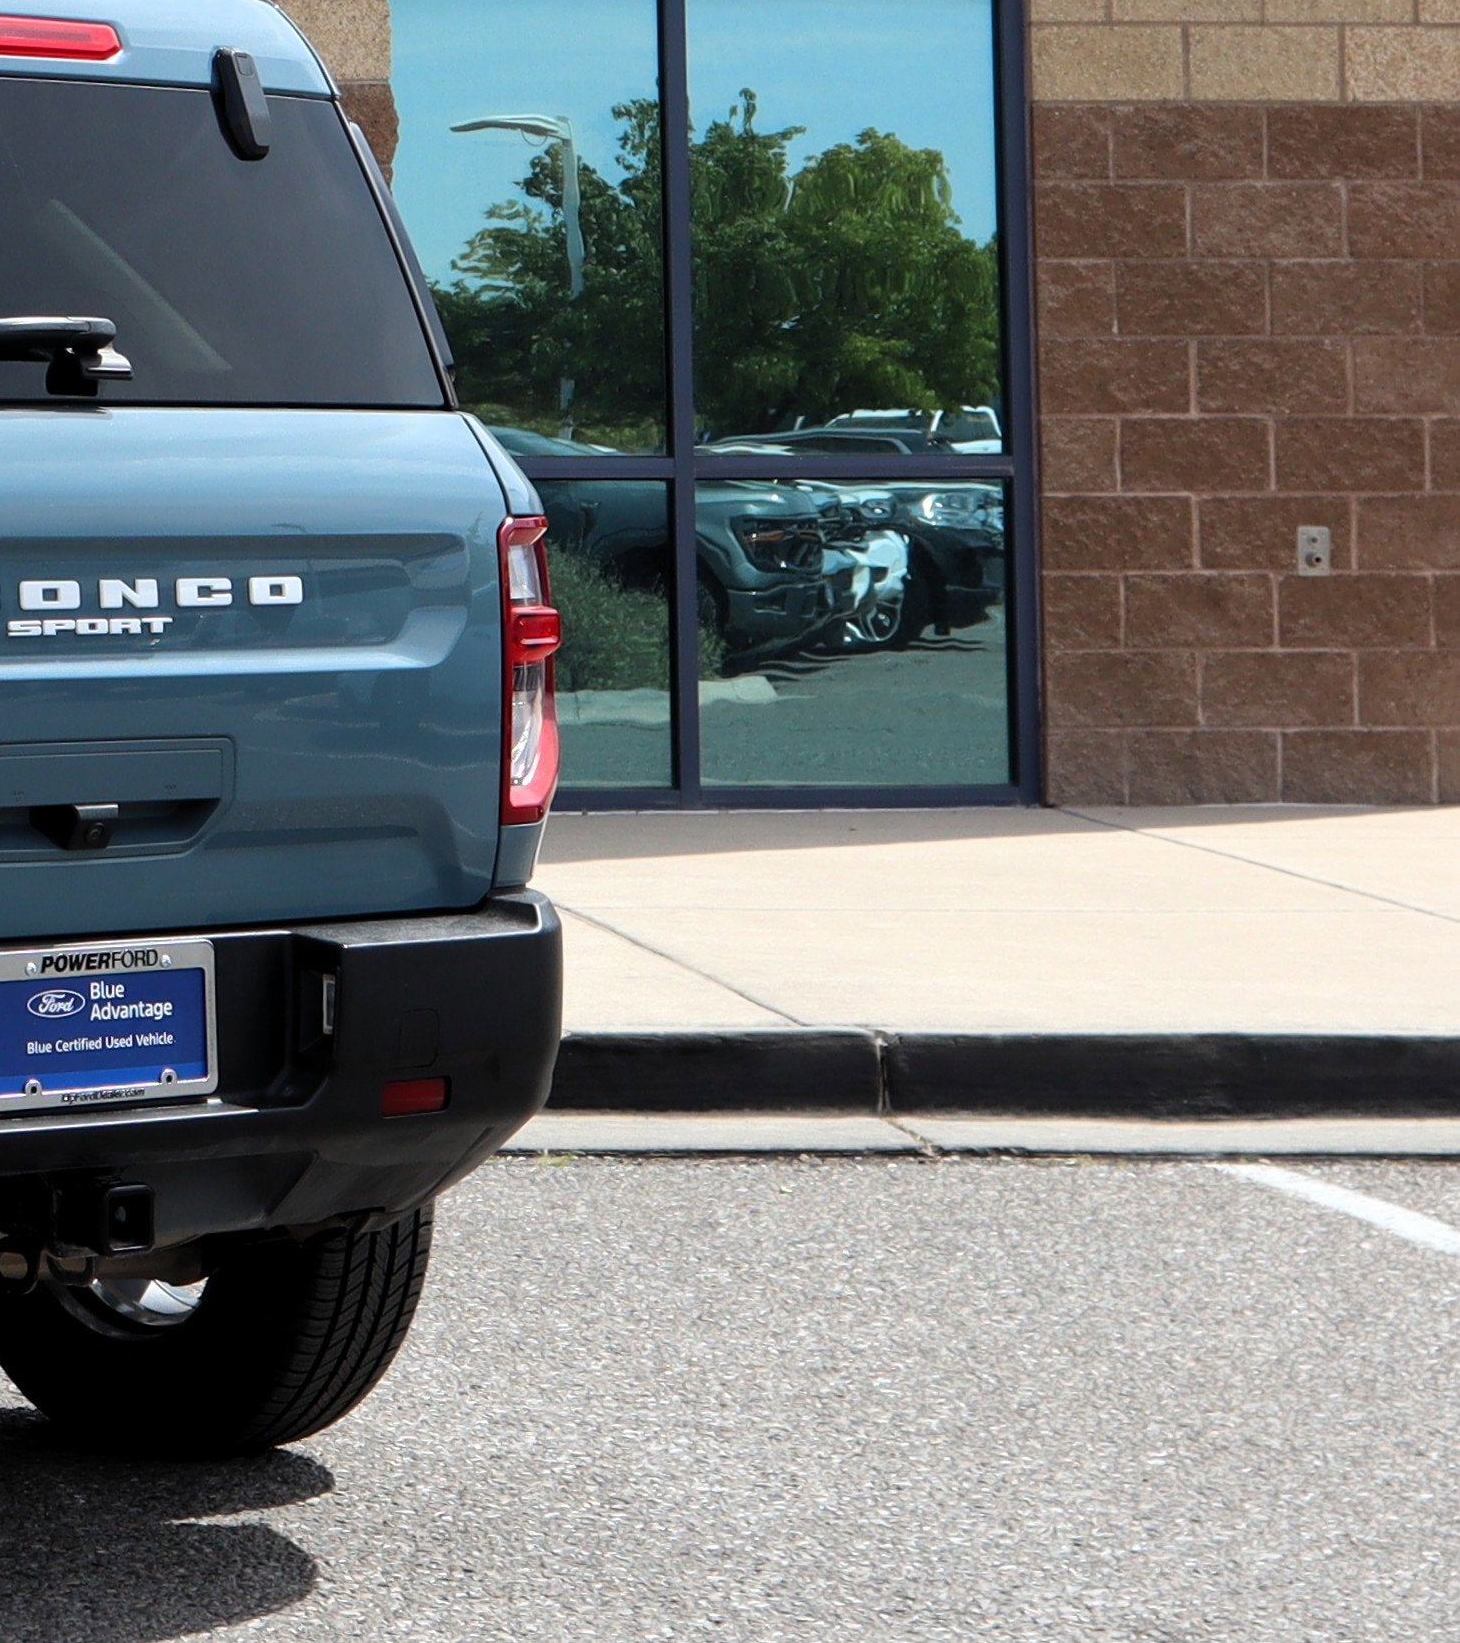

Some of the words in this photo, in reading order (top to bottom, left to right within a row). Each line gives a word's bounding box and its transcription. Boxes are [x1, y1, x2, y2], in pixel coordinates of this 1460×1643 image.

[7, 617, 174, 638] SPORT
[40, 949, 159, 974] POWERFORD
[90, 980, 125, 1000] Blue
[38, 993, 75, 1014] Ford
[90, 1001, 173, 1021] Advantage
[26, 1041, 53, 1055] Blue
[55, 1037, 102, 1052] Certified
[105, 1034, 133, 1049] Used
[136, 1031, 174, 1046] Vehicle
